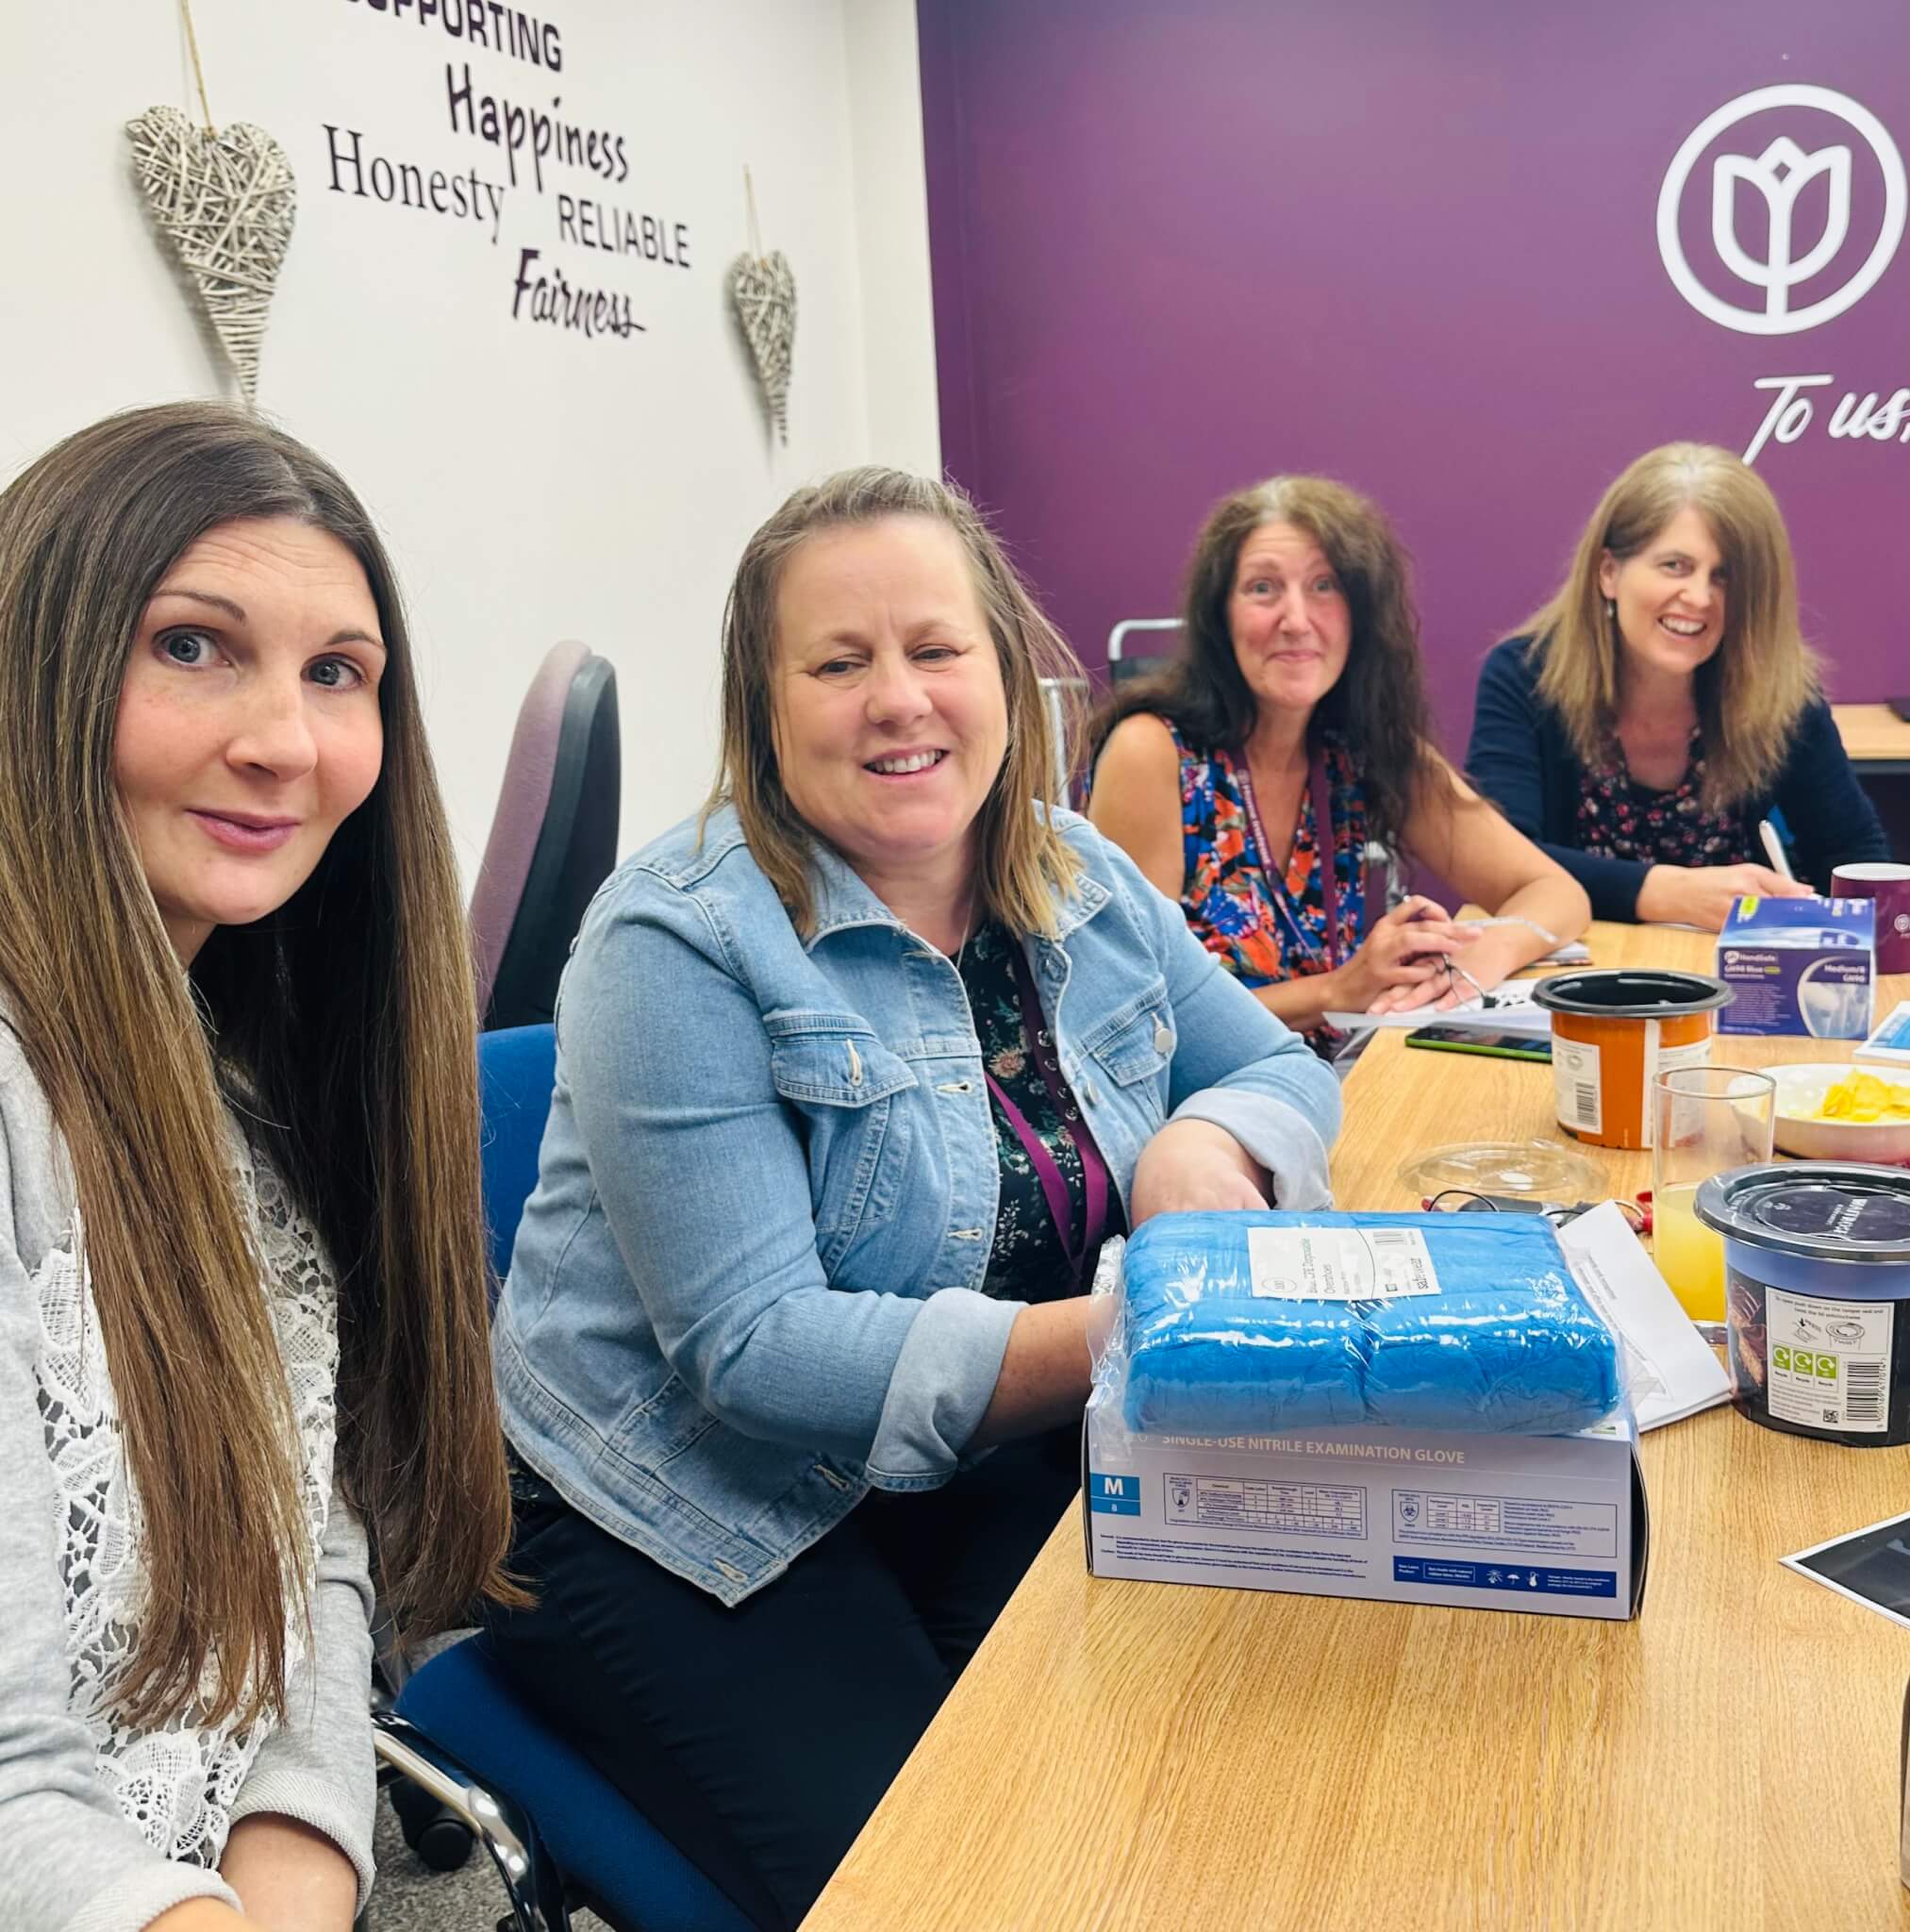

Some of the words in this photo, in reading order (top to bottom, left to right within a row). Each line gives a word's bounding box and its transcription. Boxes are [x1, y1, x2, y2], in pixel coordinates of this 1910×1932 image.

[345, 0, 562, 74] PORTING
[446, 62, 629, 192] Happiness
[322, 124, 505, 244] Honesty
[558, 193, 691, 269] RELIABLE
[512, 247, 647, 339] Fairness
[1742, 374, 1835, 467] To
[1104, 1477, 1123, 1495] M
[1161, 1435, 1245, 1450] SINGLE-USE
[1248, 1437, 1303, 1454] NITRILE
[1306, 1441, 1411, 1460] EXAMINATION
[1415, 1448, 1465, 1464] GLOVE
